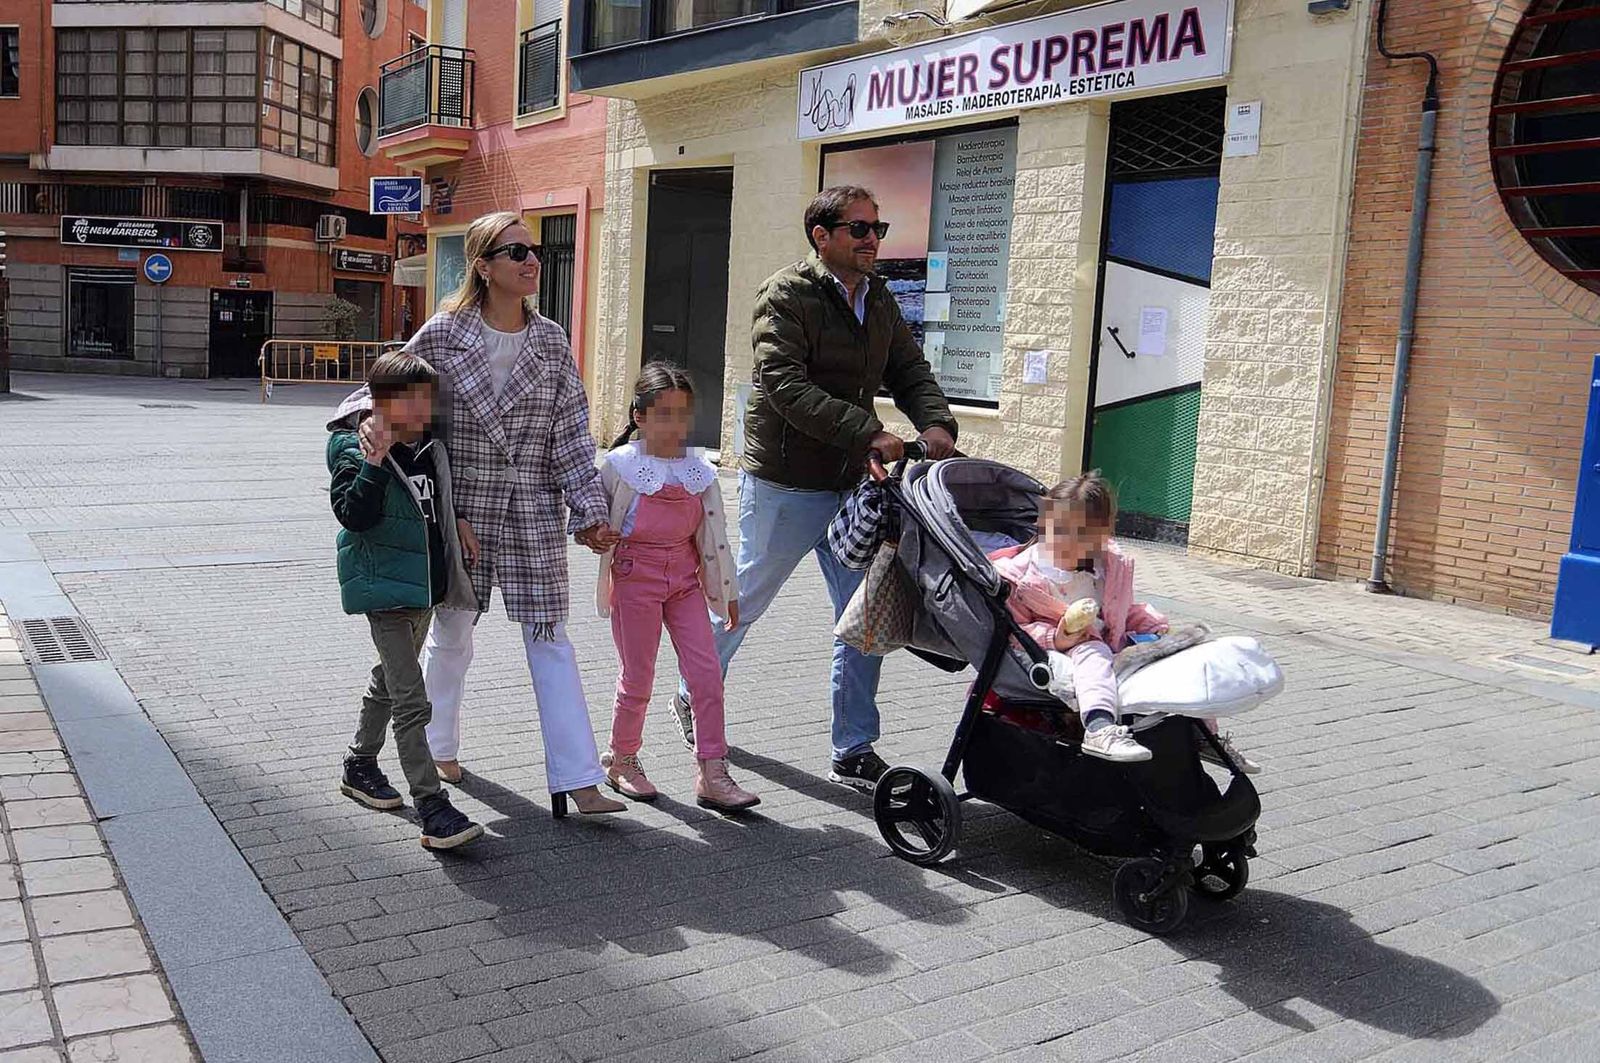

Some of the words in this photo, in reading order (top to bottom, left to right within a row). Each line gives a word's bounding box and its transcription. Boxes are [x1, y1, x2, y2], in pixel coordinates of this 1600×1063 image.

[866, 51, 980, 111] MUJER
[989, 7, 1206, 90] SUPREMA
[905, 100, 953, 120] MASAJES
[962, 83, 1062, 111] MADEROTERAPIA
[957, 140, 1005, 150] Maderoterapia
[956, 167, 971, 177] Reloj
[973, 167, 981, 175] de
[982, 166, 1003, 175] Arena
[940, 182, 961, 192] Masaje
[962, 180, 988, 189] reductor
[949, 194, 970, 203] Masaje
[951, 207, 975, 216] Drenaje
[944, 220, 966, 229] Masaje
[967, 219, 975, 227] de
[72, 225, 90, 234] THE
[89, 226, 112, 235] NEW
[111, 228, 158, 237] BARBERS
[944, 233, 966, 242] Masaje
[967, 232, 975, 240] de
[948, 245, 970, 255] Masaje
[955, 270, 989, 280] Cavitación
[943, 346, 975, 357] Depilación
